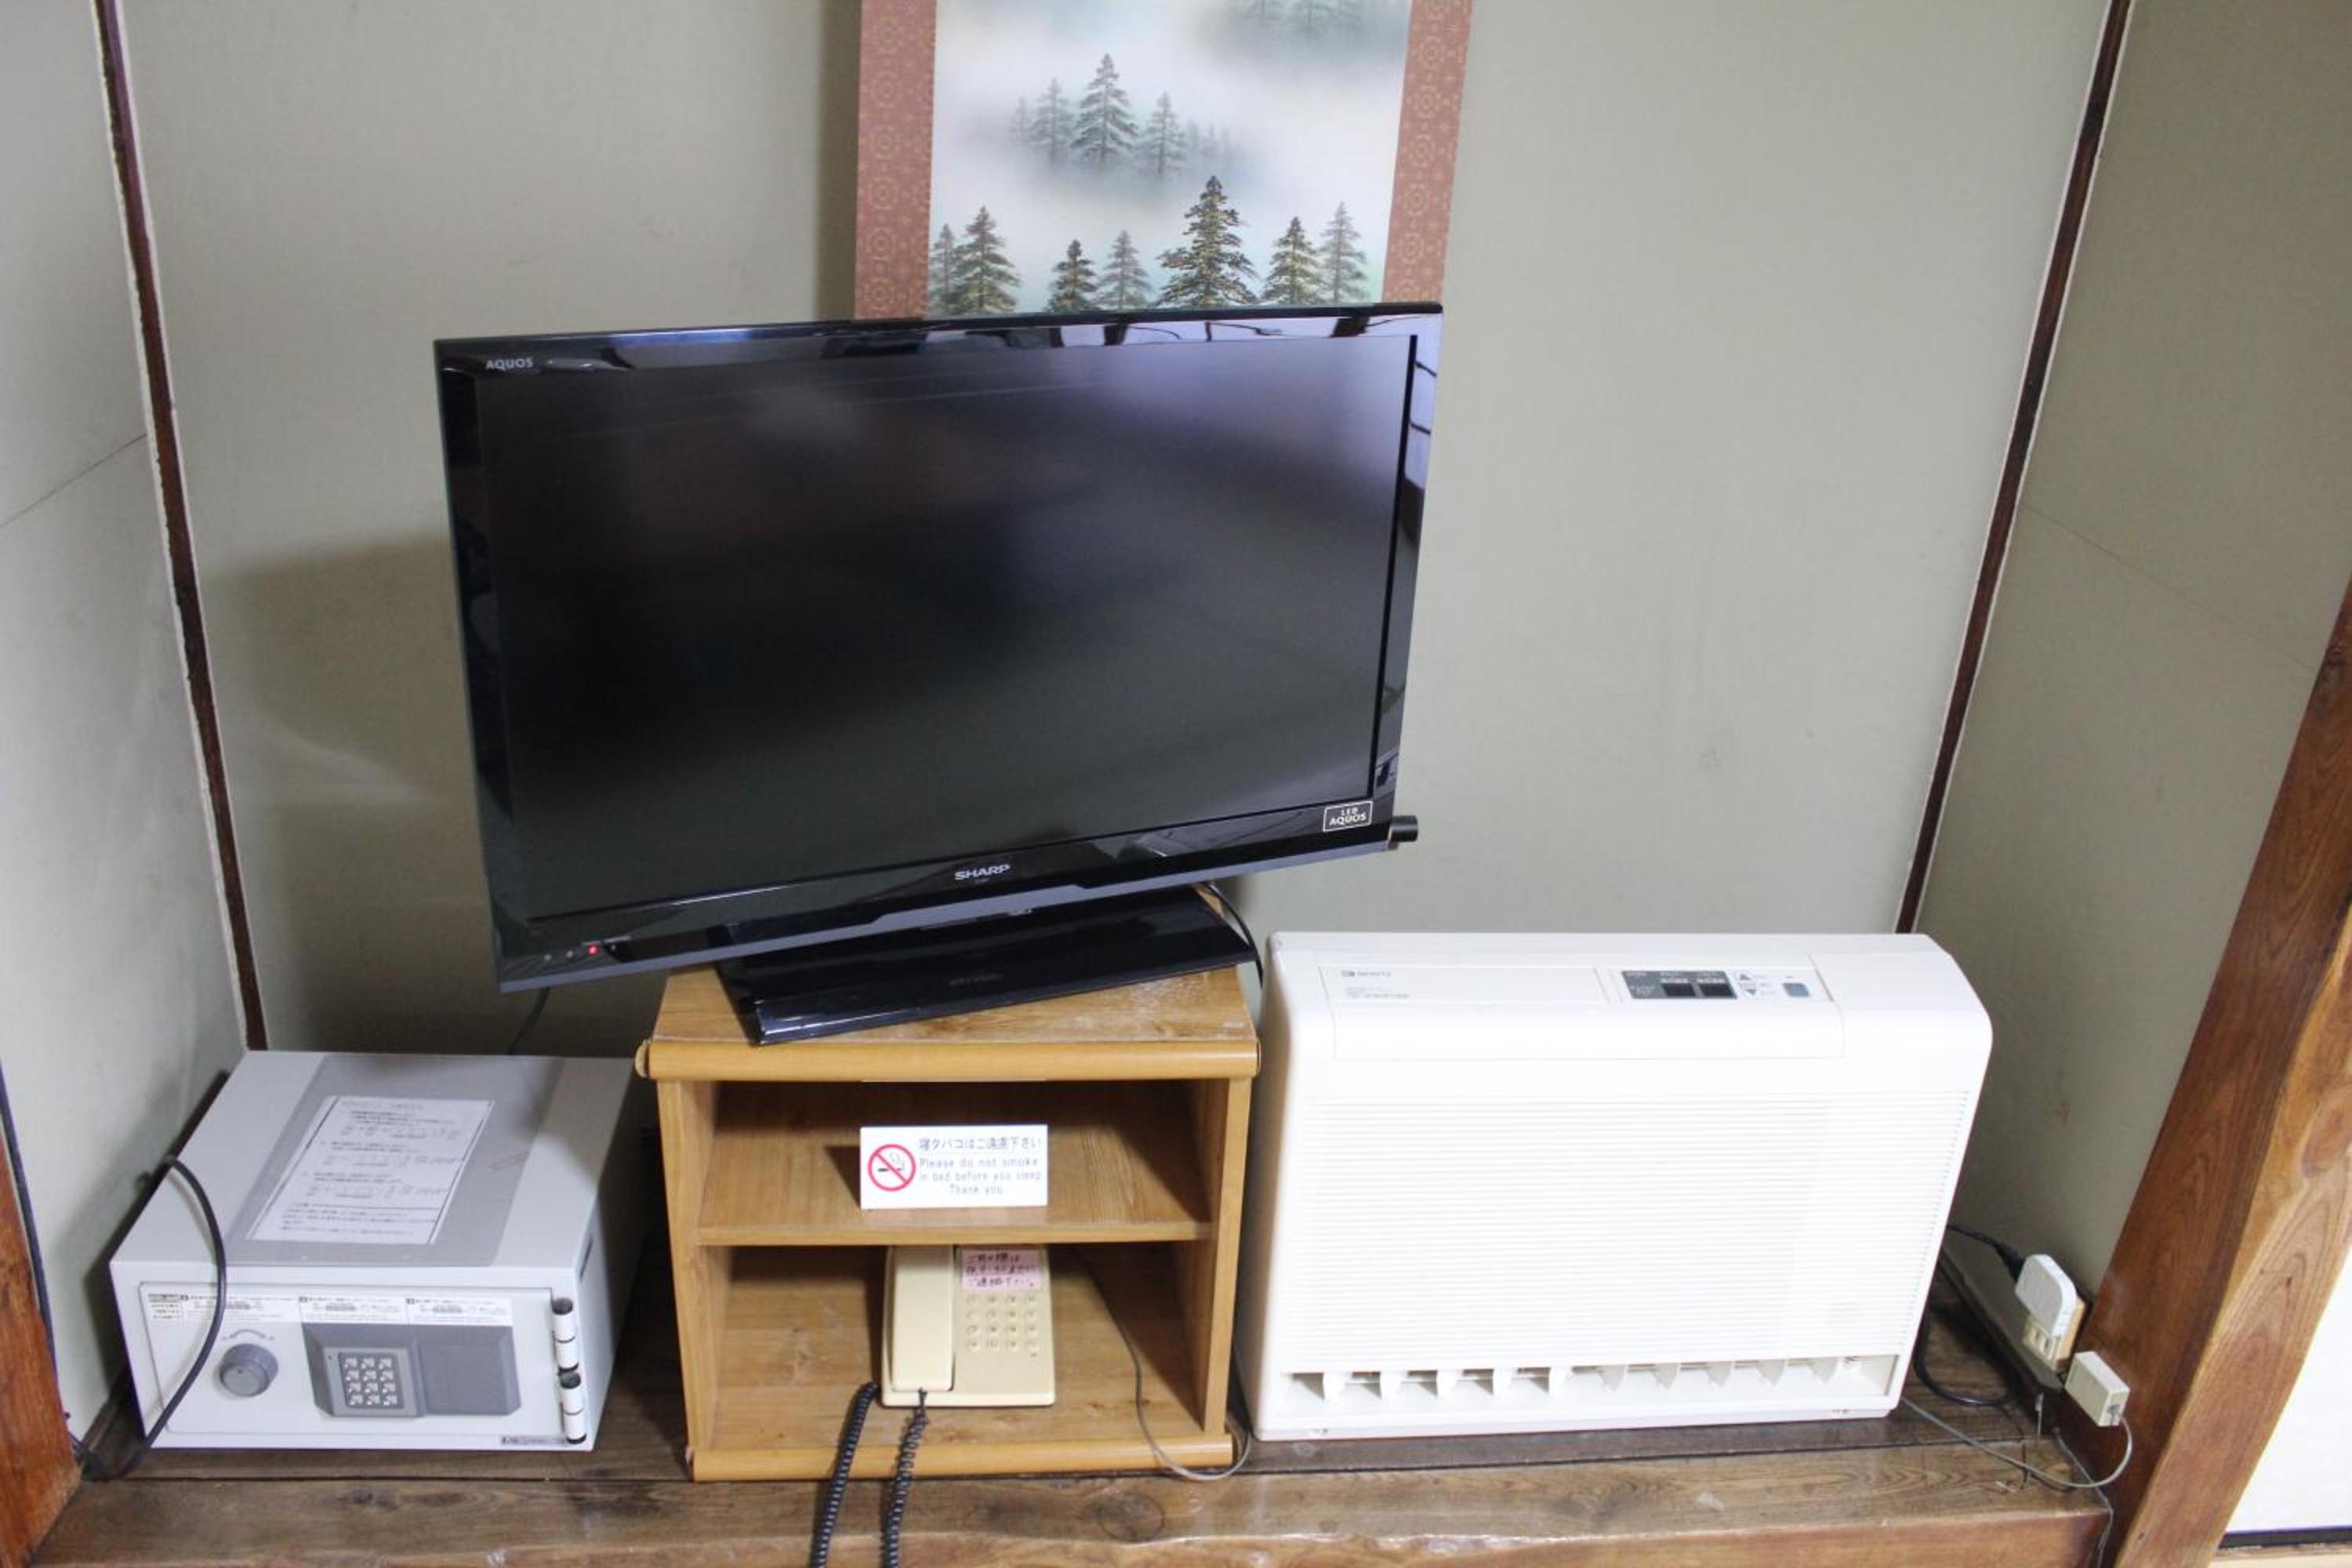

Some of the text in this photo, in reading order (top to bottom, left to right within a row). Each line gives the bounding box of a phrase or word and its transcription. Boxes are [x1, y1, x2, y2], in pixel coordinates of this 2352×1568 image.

[486, 358, 534, 371] AQUOS
[1341, 807, 1359, 816] LED
[1329, 812, 1367, 826] AQUOS
[954, 864, 1011, 880] SHARP
[920, 1157, 1037, 1168] Please do not smoke
[933, 1171, 950, 1181] bed
[955, 1171, 988, 1181] before
[993, 1172, 1011, 1183] you
[949, 1183, 978, 1194] Thank
